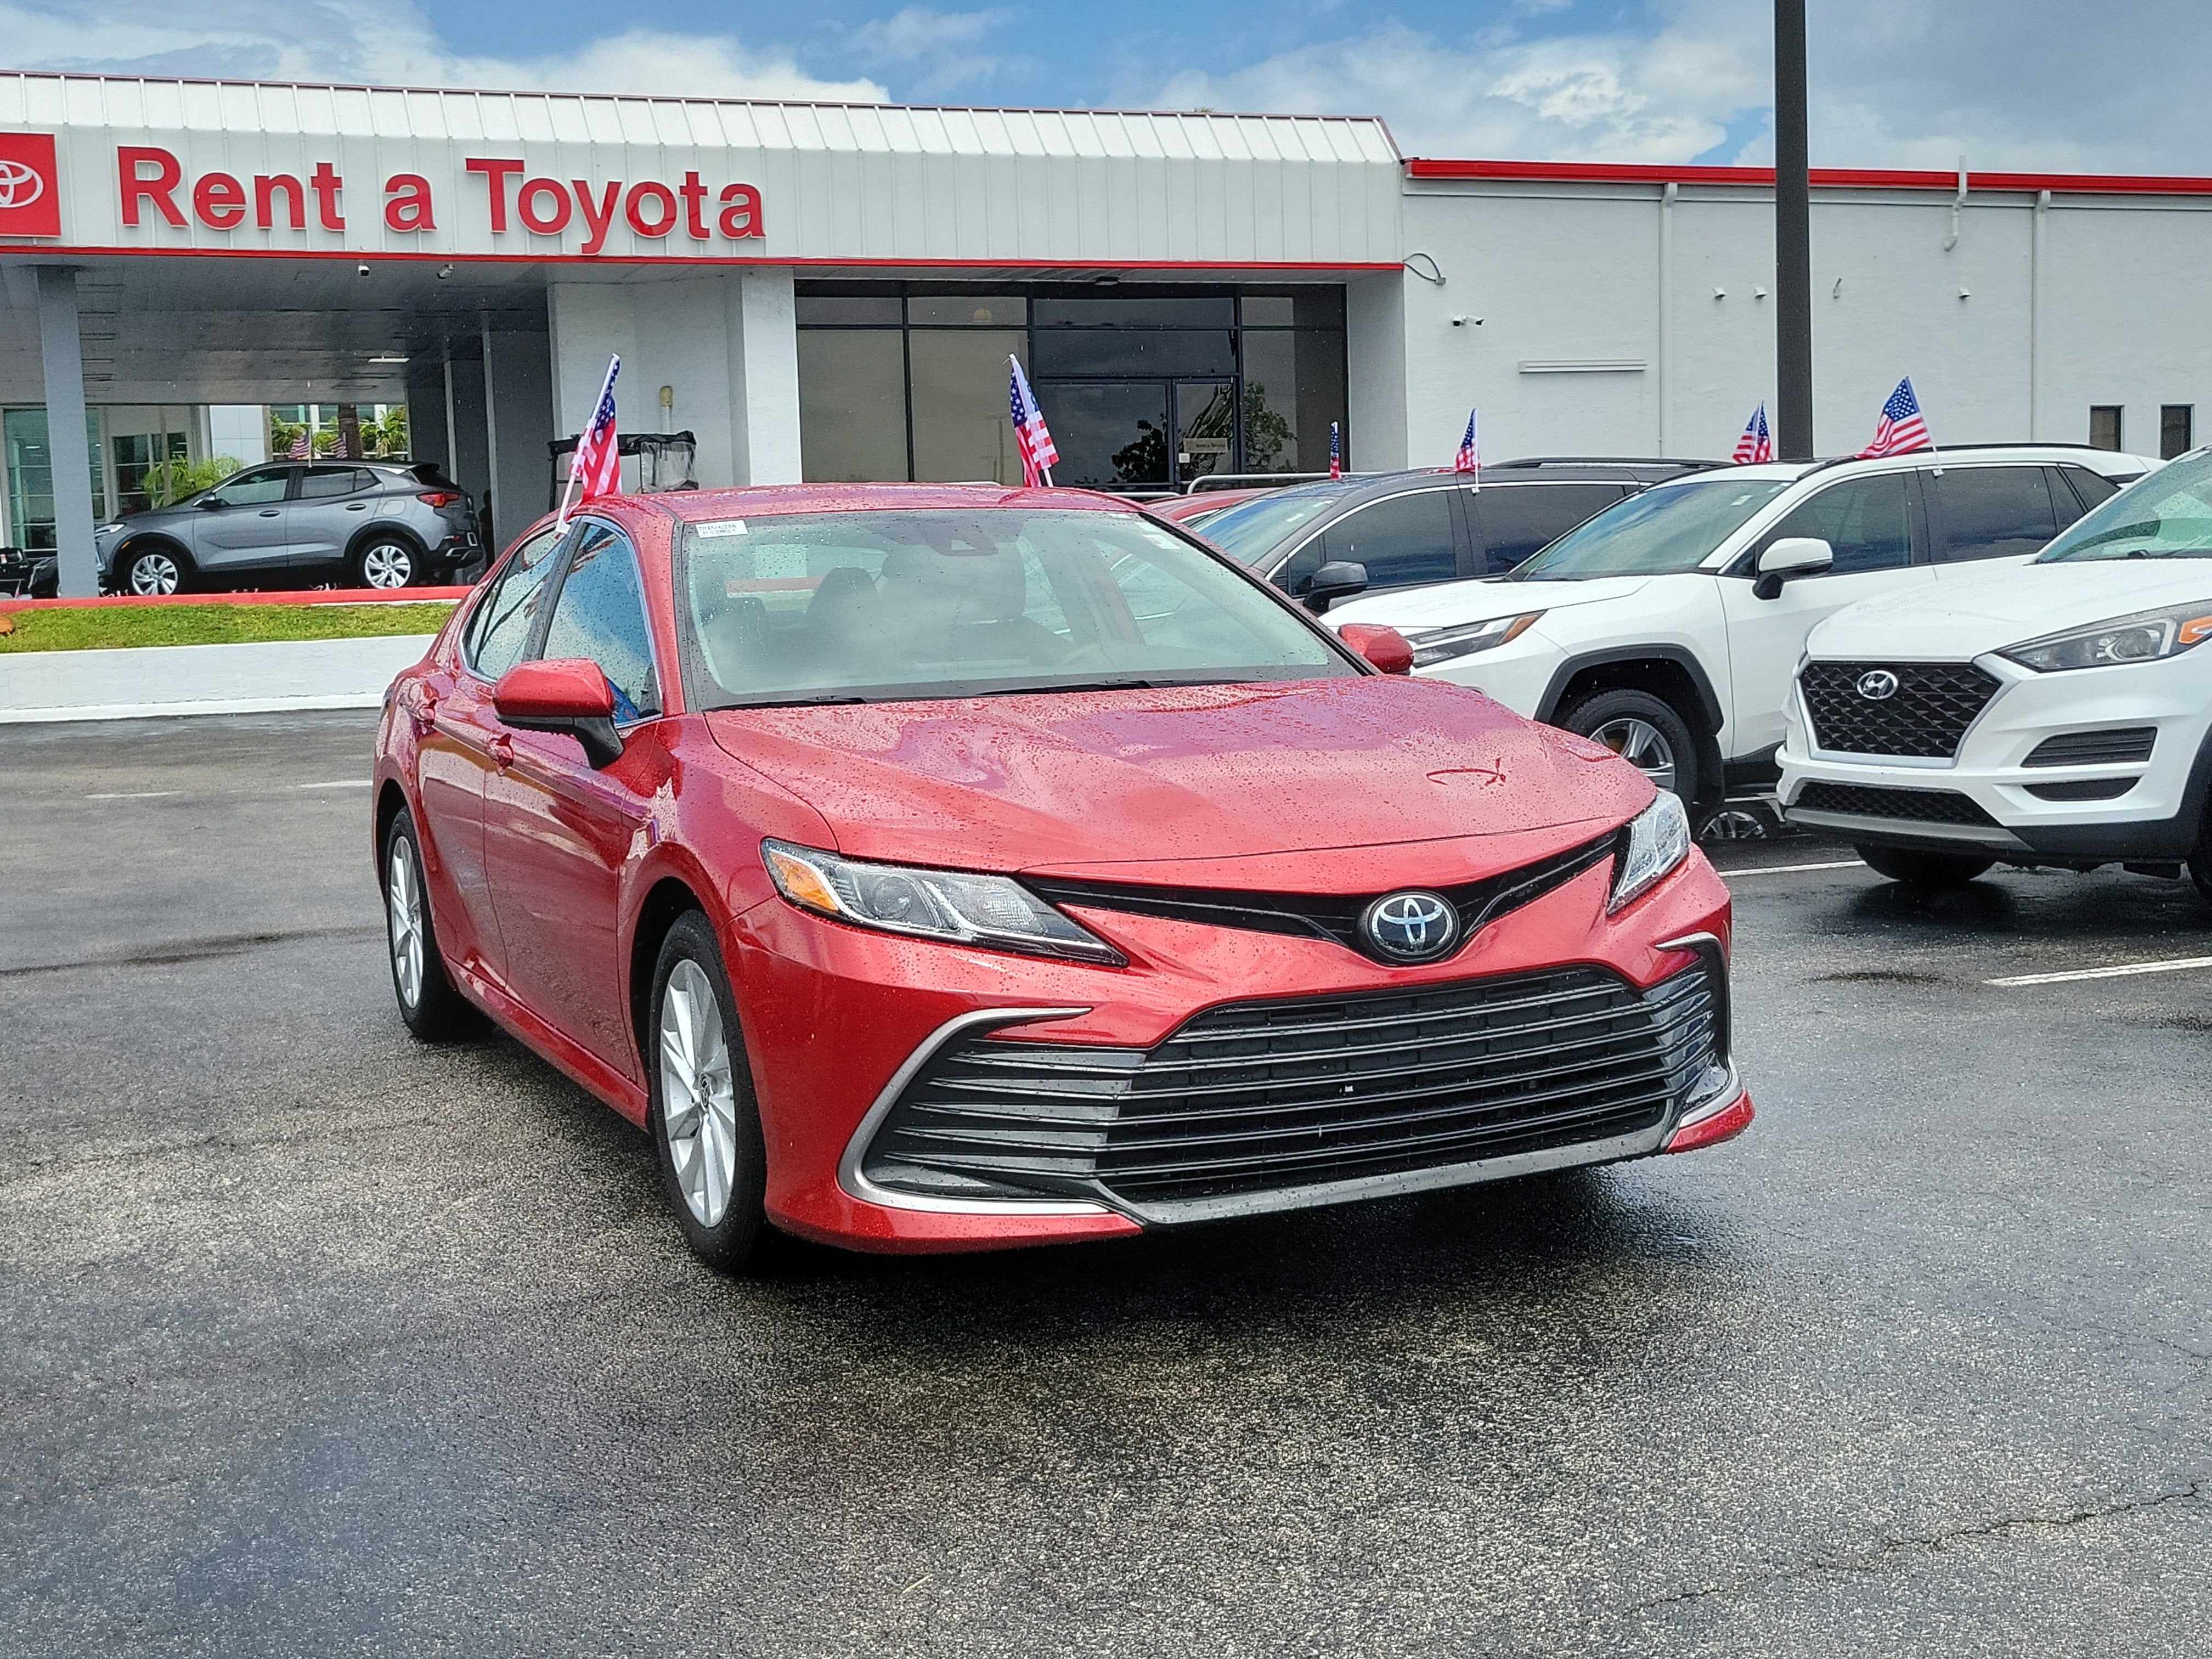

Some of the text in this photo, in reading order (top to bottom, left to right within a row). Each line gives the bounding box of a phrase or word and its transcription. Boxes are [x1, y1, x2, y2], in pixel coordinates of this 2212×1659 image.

[117, 146, 766, 256] Rent a Toyota
